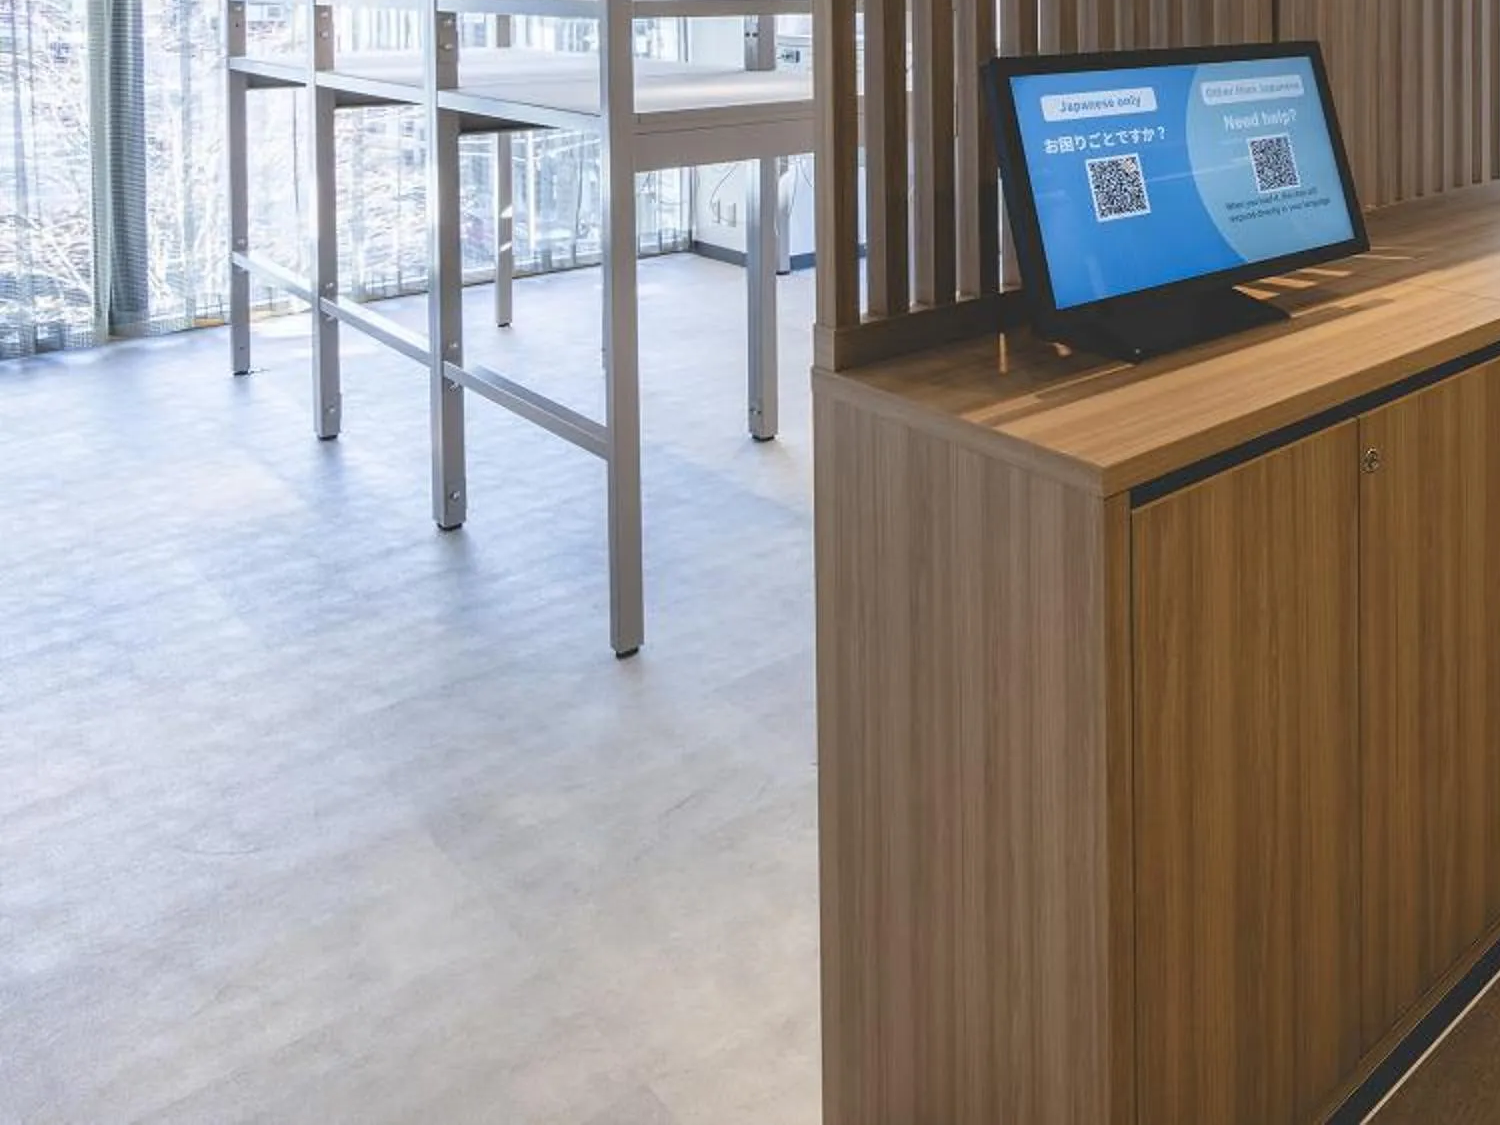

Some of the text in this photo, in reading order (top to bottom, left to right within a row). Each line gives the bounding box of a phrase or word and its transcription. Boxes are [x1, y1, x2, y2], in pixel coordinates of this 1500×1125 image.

[1059, 94, 1141, 113] Japanese only
[1223, 107, 1296, 131] Need help?
